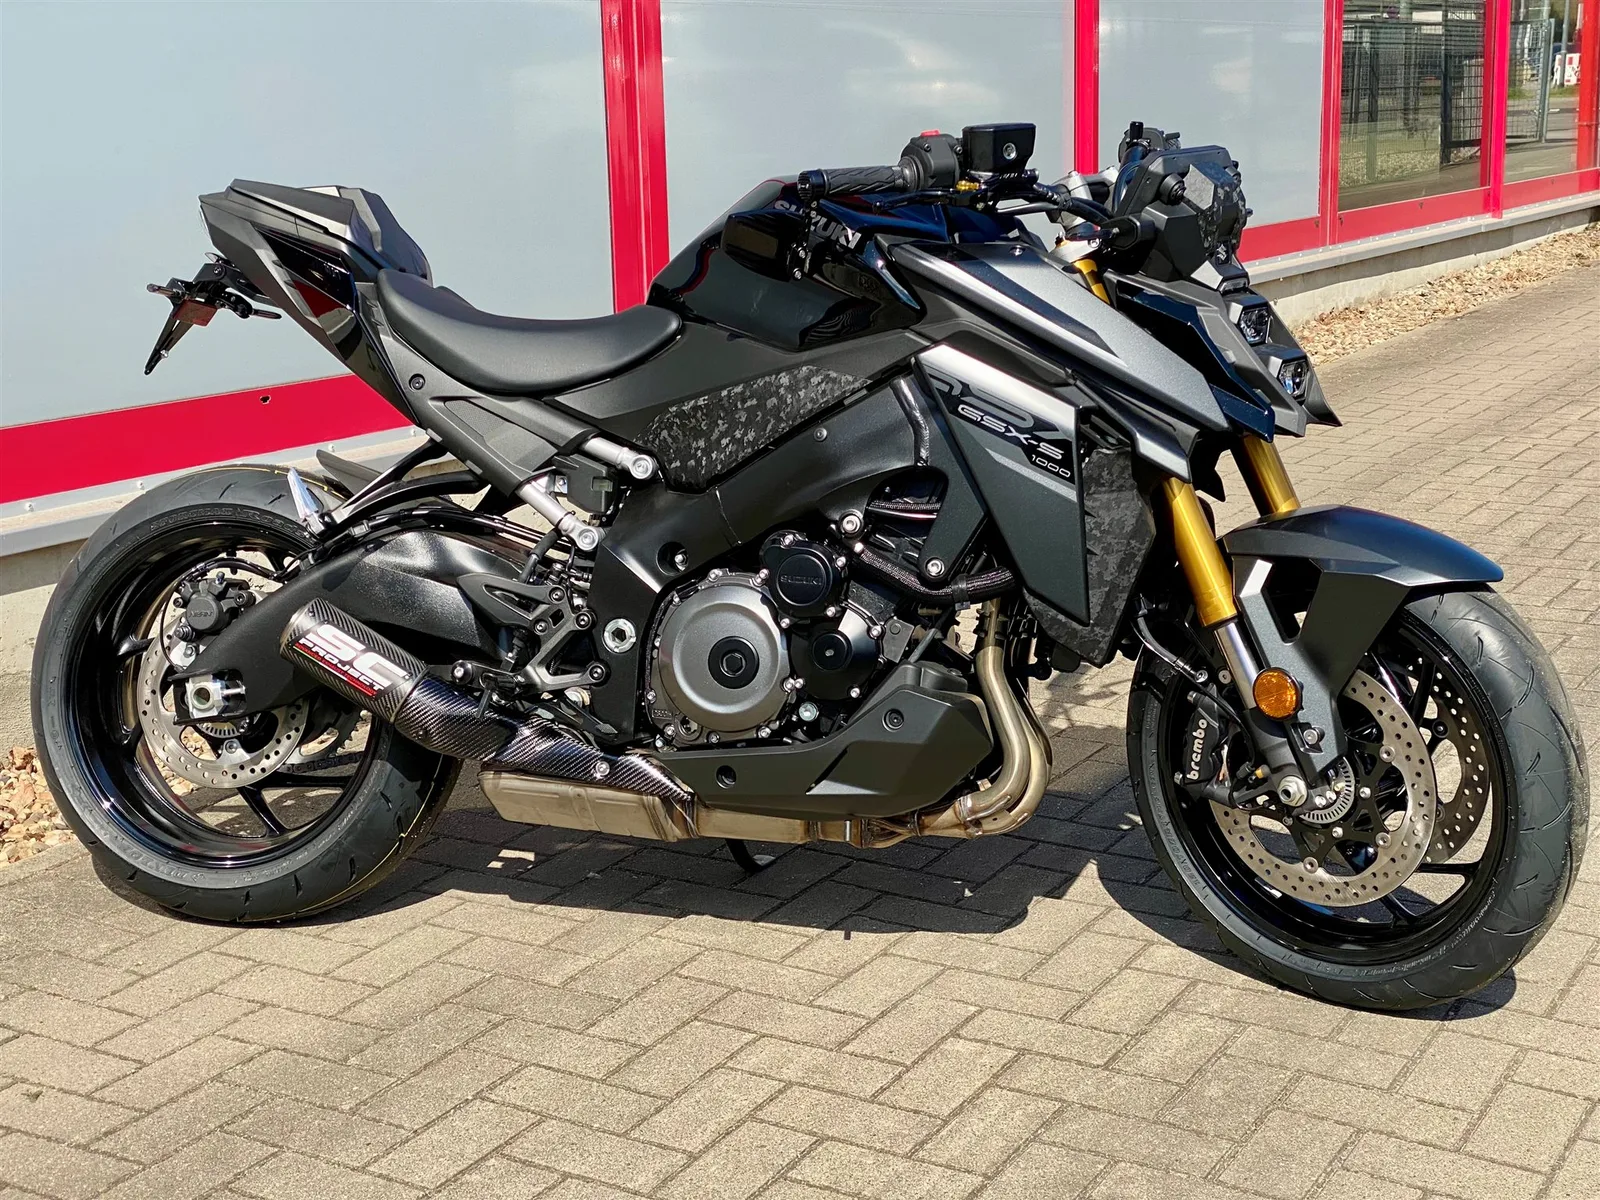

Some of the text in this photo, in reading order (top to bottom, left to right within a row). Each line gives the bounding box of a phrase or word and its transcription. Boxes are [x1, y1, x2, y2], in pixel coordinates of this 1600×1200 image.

[957, 404, 1065, 461] GSX-S
[1031, 454, 1071, 478] 1000
[298, 637, 385, 691] PROJECT
[305, 624, 410, 688] SC
[1186, 719, 1208, 780] brembo
